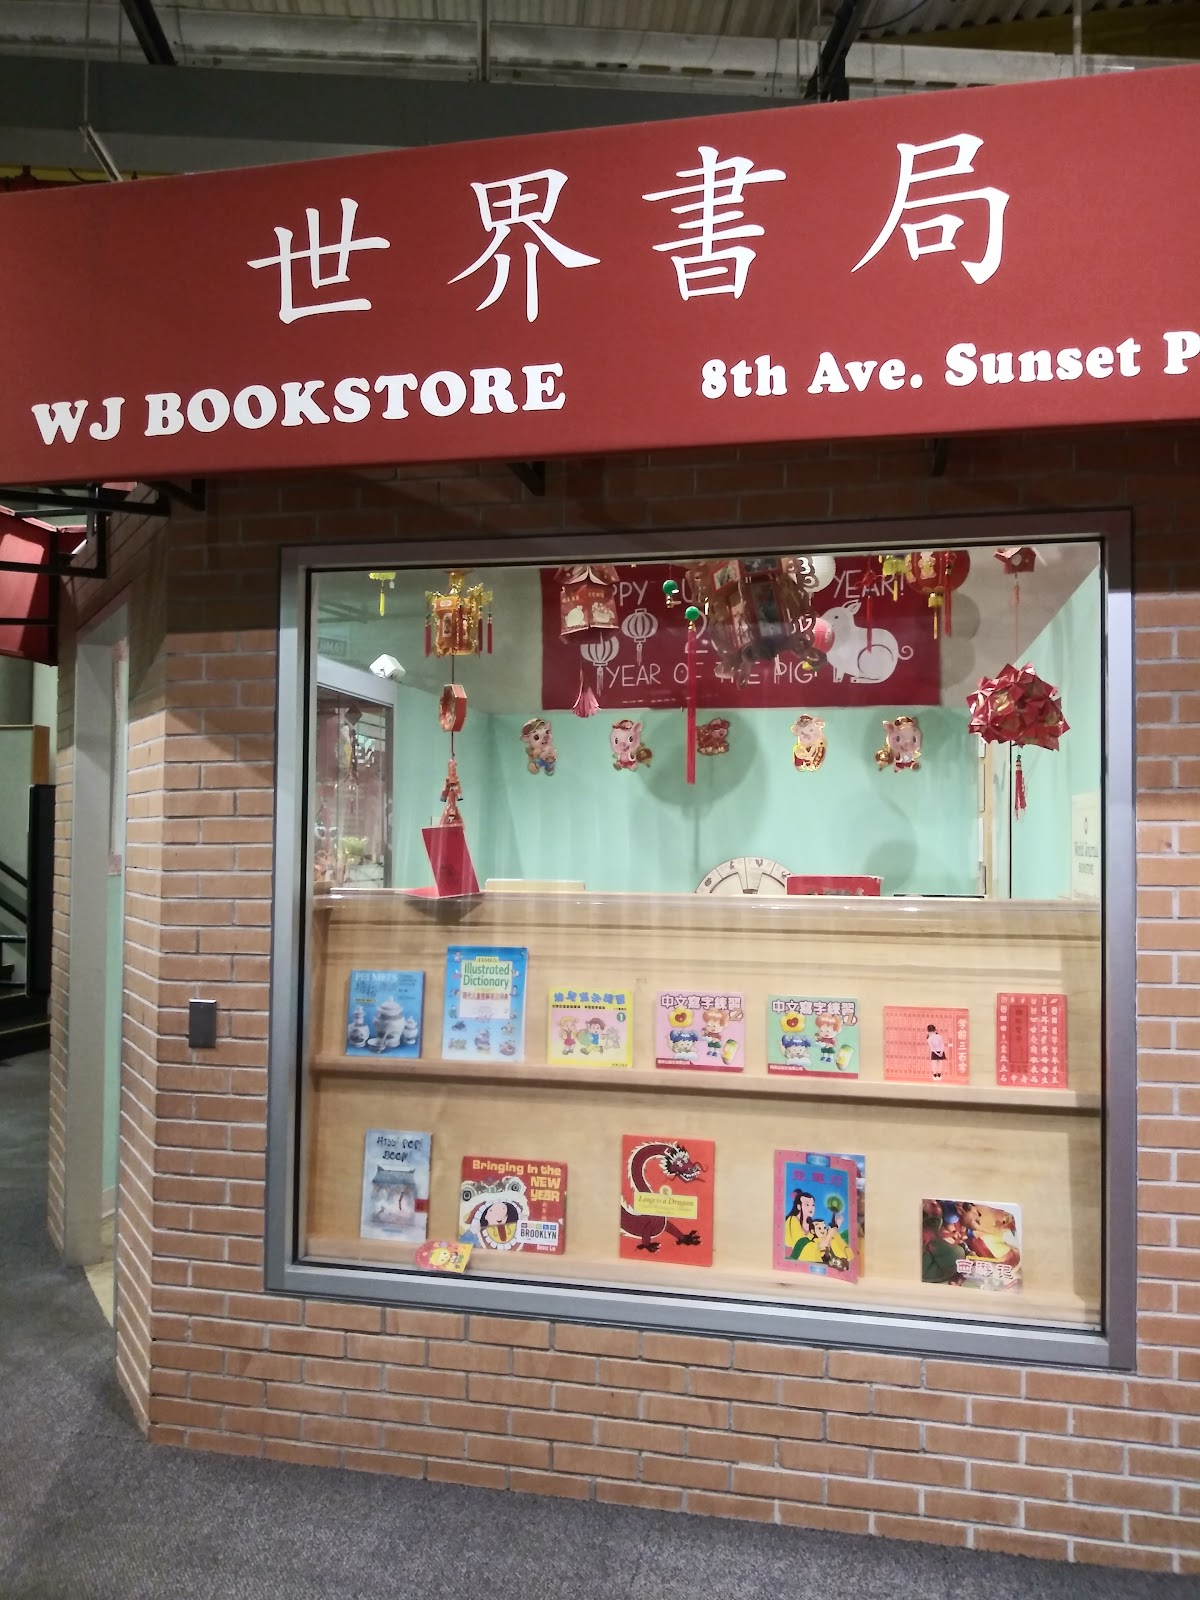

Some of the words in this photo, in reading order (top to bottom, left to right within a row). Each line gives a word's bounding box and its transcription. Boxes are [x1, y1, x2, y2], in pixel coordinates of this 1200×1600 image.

[246, 132, 1010, 325] 世界書局
[701, 358, 788, 399] 8th
[806, 351, 923, 394] Ave.
[944, 337, 1142, 388] Sunset
[31, 396, 125, 446] WJ
[144, 362, 566, 438] BOOKSTORE
[606, 663, 661, 688] YEAR
[464, 962, 510, 975] Illustrated
[463, 974, 509, 990] Dictionary
[661, 993, 742, 1011] 中文寫字練習
[772, 999, 856, 1016] 中文寫字練習
[472, 1159, 524, 1175] Bringing
[540, 1165, 562, 1176] the
[530, 1176, 562, 1189] NEW
[530, 1188, 560, 1202] YEAR
[668, 1197, 694, 1207] Dragon
[520, 1229, 557, 1240] BROOKLYN
